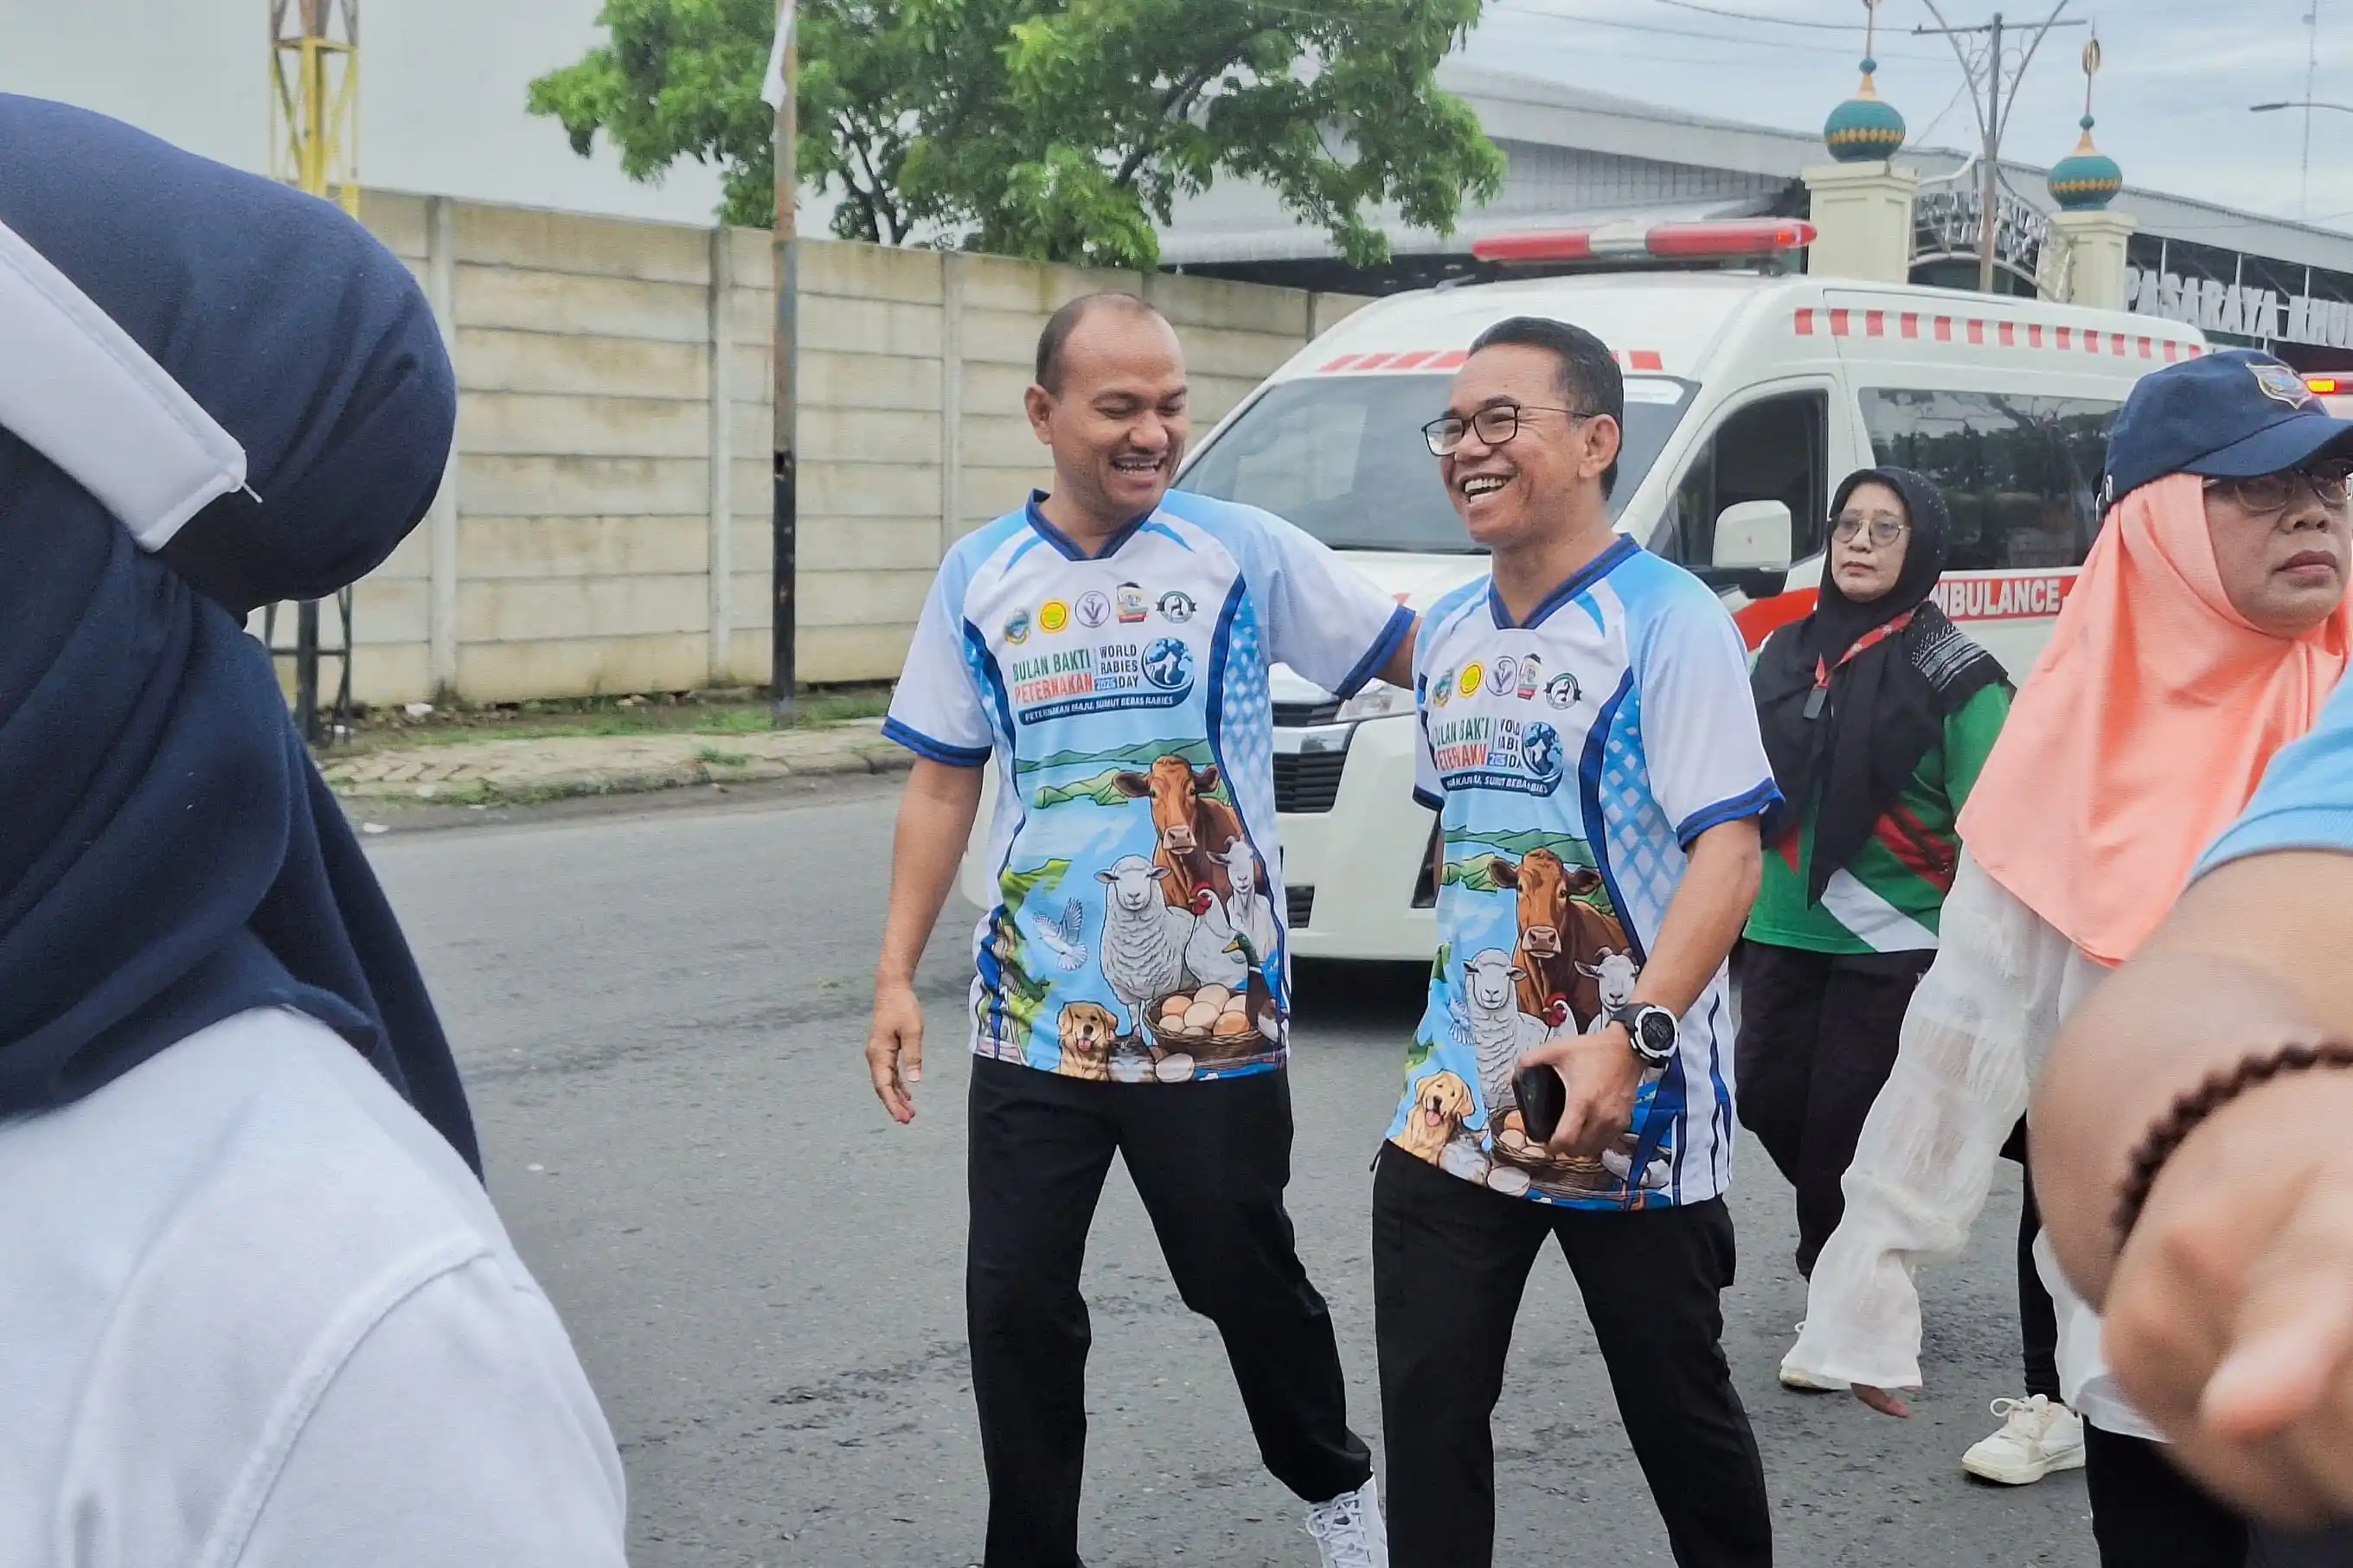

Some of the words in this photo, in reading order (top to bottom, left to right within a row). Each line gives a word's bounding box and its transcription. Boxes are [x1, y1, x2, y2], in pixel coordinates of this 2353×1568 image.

[1929, 579, 2060, 617] MBULANCE
[1100, 644, 1137, 658] WORLD
[1012, 655, 1049, 682] BULAN
[1053, 649, 1091, 674] BAKTI
[1100, 660, 1138, 675] RABIES
[1015, 673, 1093, 706] PETERNAKAN
[1119, 675, 1138, 688] DAY
